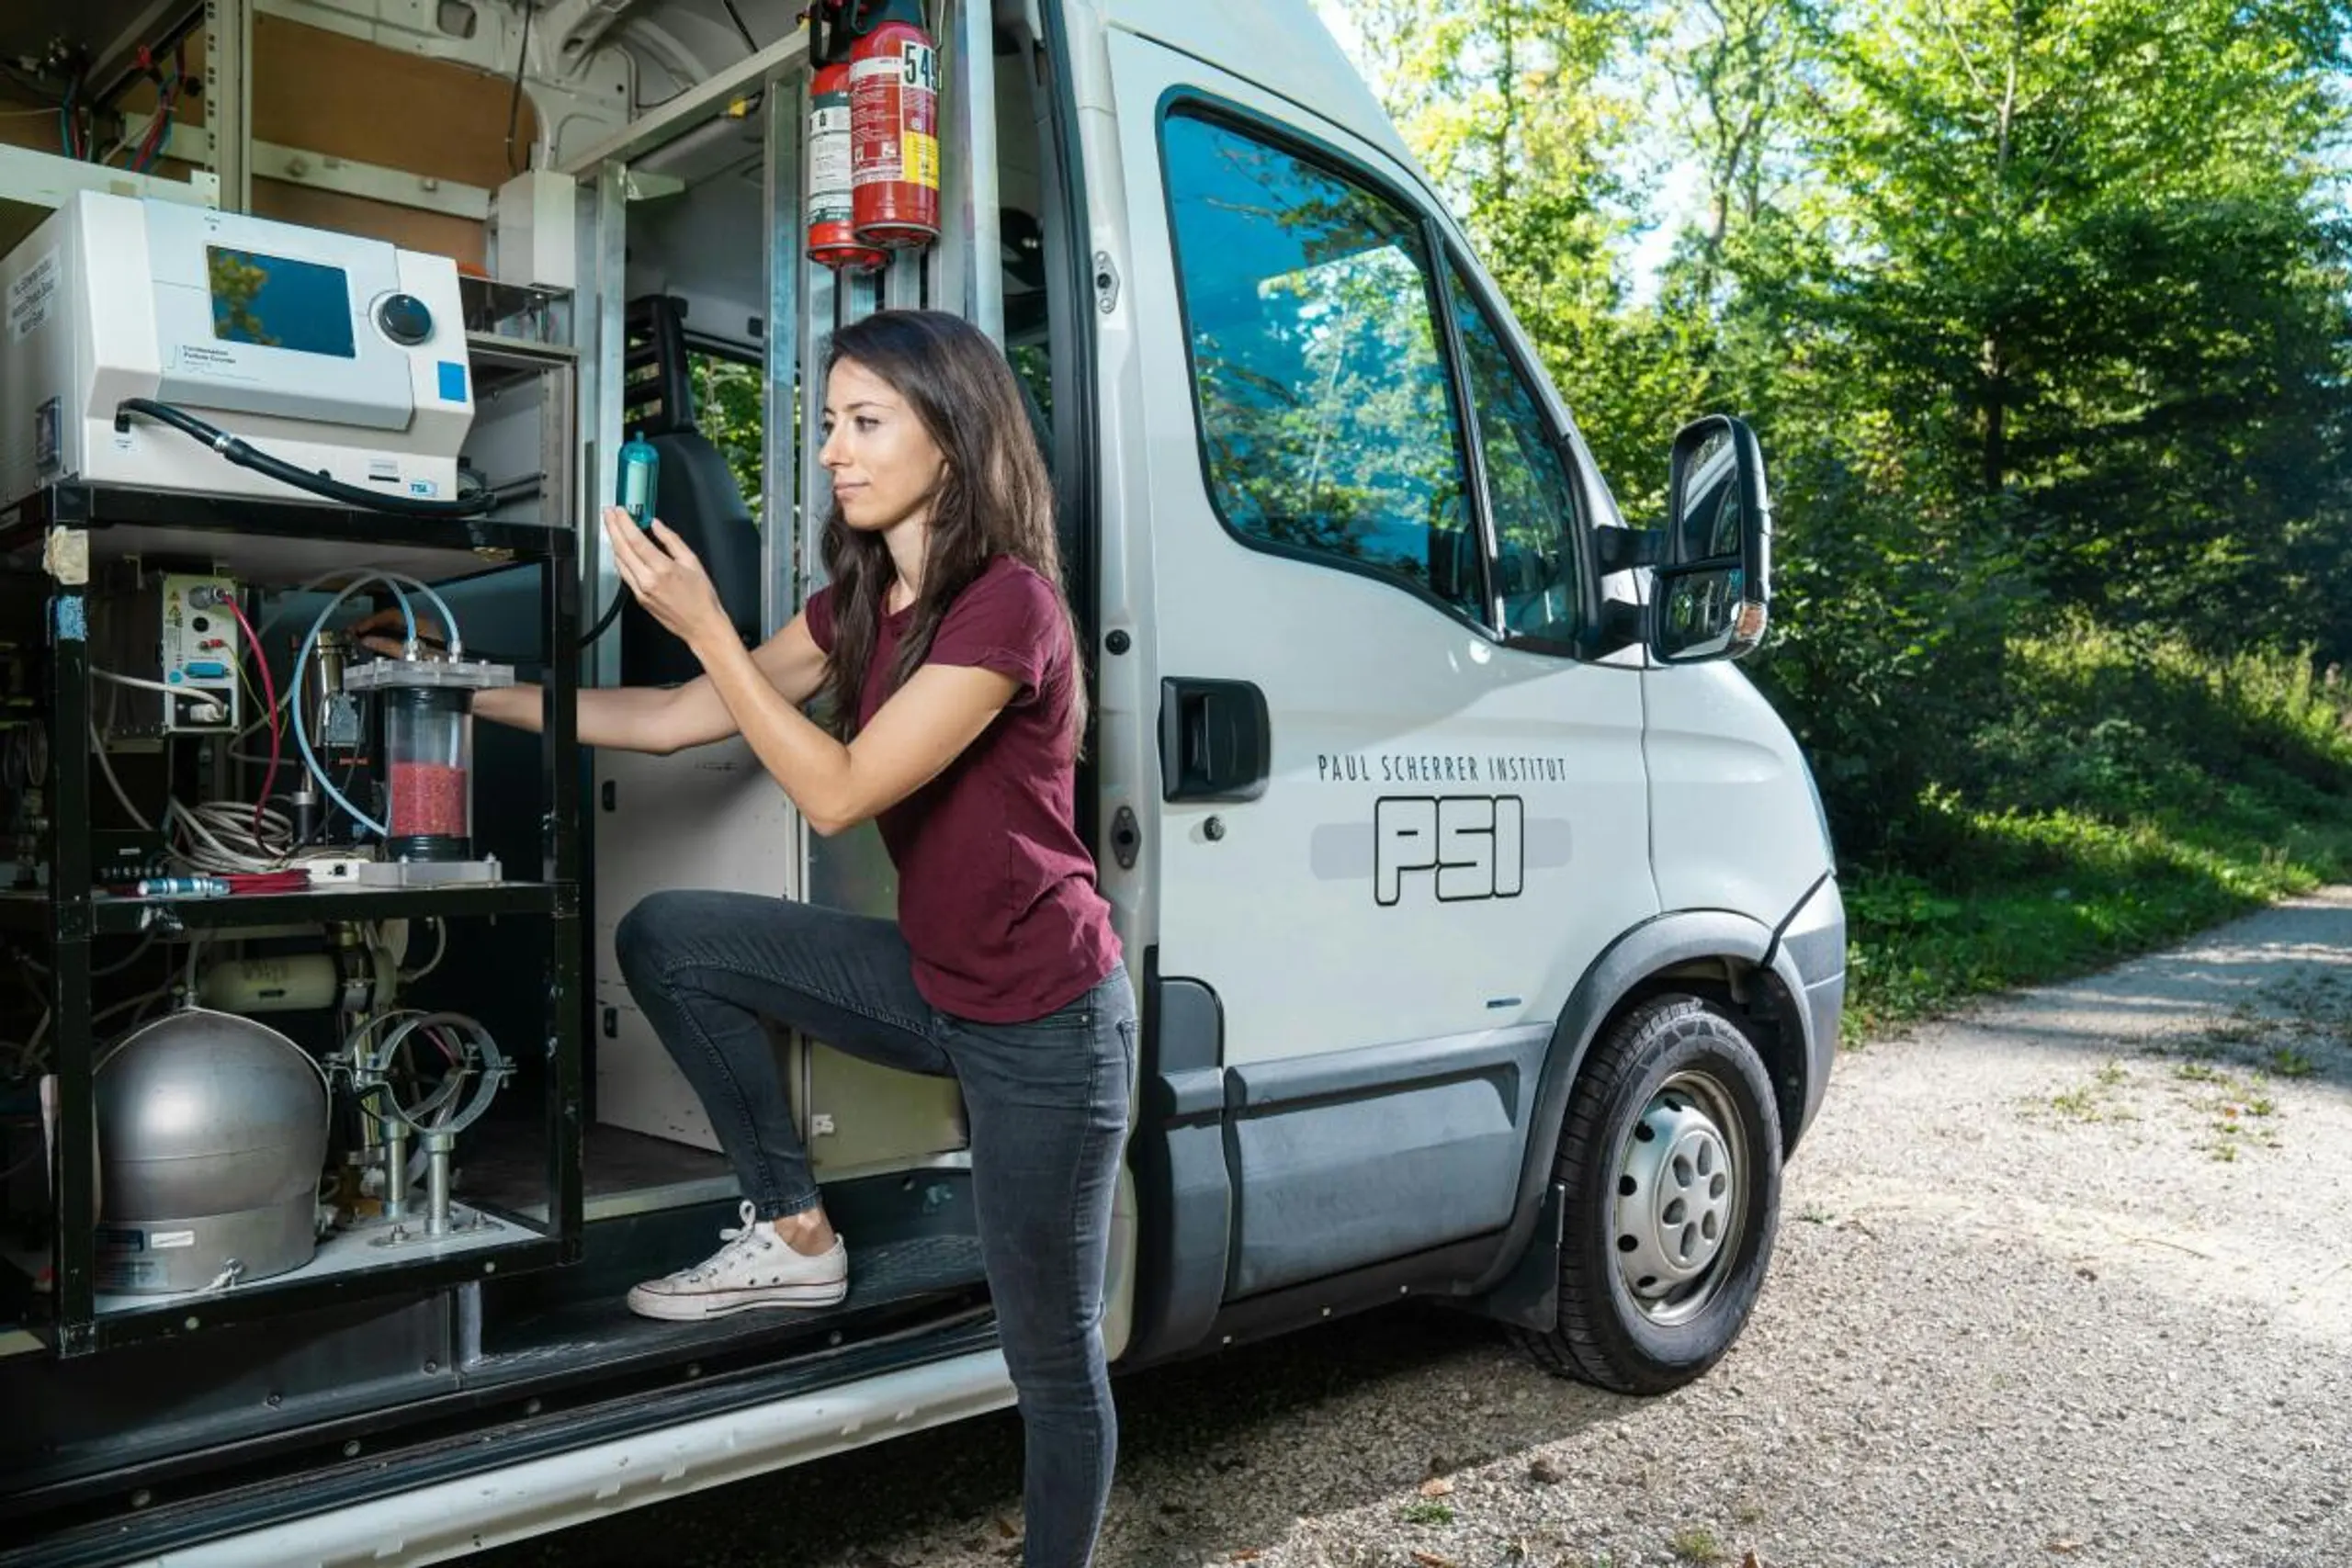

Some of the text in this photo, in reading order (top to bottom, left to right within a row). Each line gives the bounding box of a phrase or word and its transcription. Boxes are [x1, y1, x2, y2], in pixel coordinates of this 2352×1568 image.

[1317, 753, 1566, 782] PAUL SCHERRER INSTITUT
[1374, 795, 1524, 907] PSI
